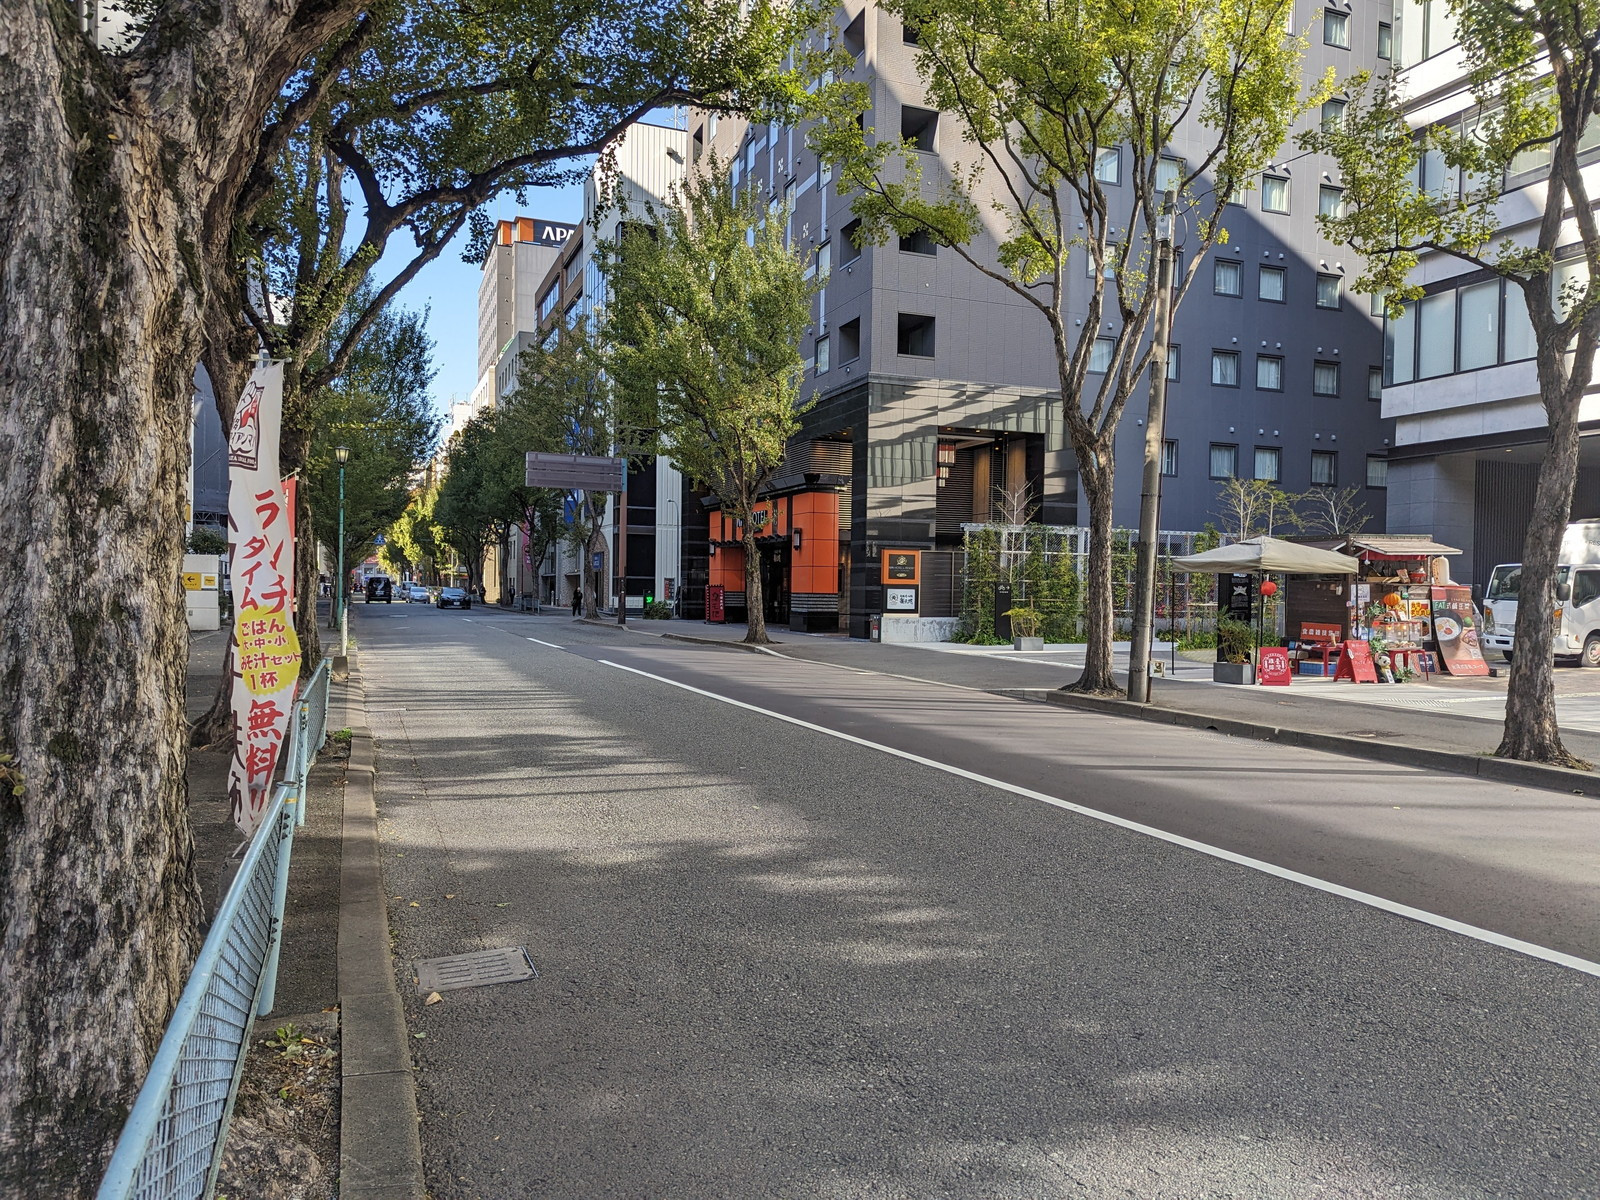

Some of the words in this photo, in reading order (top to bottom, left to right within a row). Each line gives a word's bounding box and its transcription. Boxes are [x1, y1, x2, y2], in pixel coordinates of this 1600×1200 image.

[241, 618, 286, 637] ごはん
[241, 652, 301, 670] みそ汁セット
[250, 671, 278, 690] 1杯
